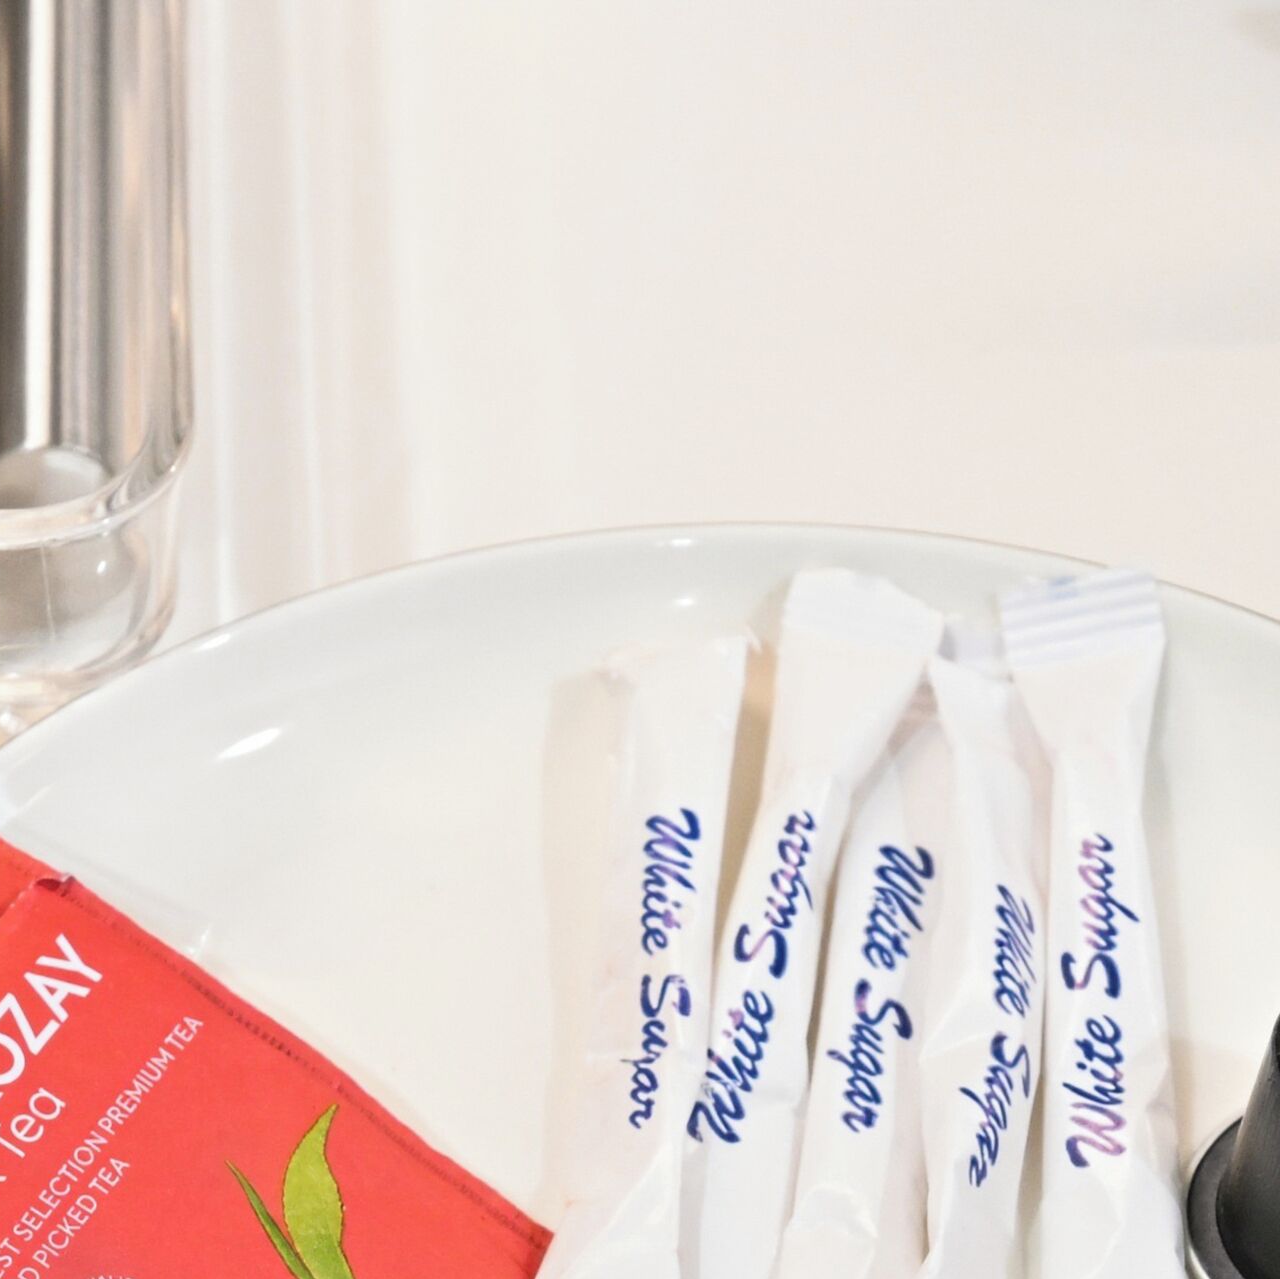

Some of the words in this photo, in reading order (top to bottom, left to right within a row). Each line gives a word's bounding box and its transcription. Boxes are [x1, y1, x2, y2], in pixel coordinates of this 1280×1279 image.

[641, 807, 701, 956] White
[861, 845, 935, 971] White
[993, 883, 1036, 1019] White
[1061, 832, 1140, 999] Sugar
[687, 989, 774, 1144] White
[734, 809, 817, 979] Sugar
[13, 1131, 108, 1241] SELECTION
[98, 1047, 175, 1135] PREMIUM
[164, 1016, 204, 1050] TEA
[826, 978, 913, 1133] Sugar
[959, 1031, 1031, 1187] Sugar
[1062, 1014, 1127, 1169] White
[33, 1194, 98, 1268] PICKED
[89, 1157, 130, 1195] TEA
